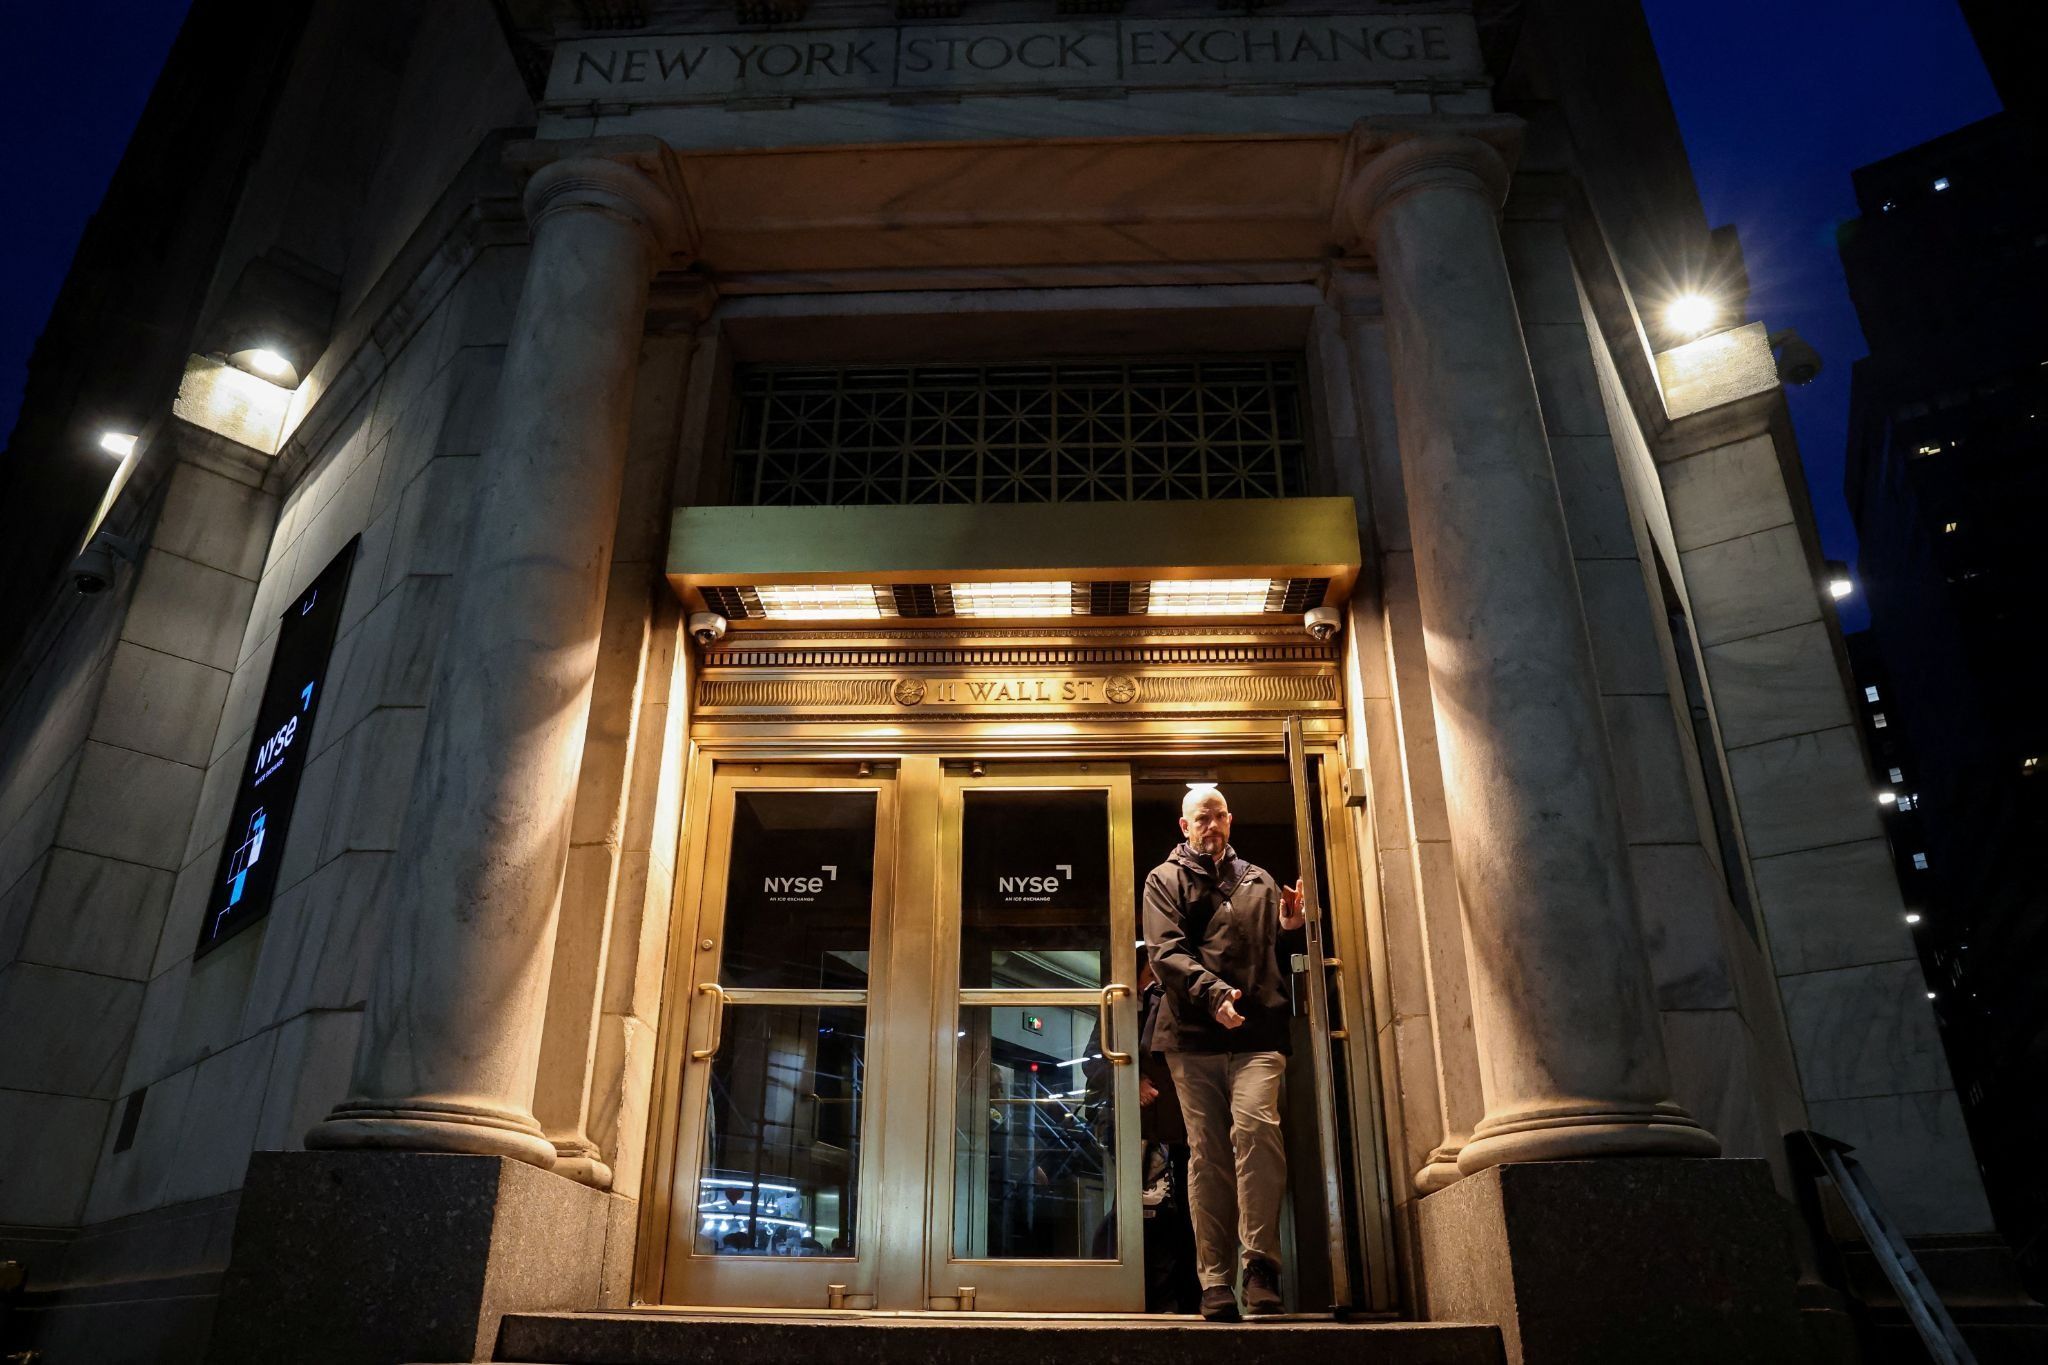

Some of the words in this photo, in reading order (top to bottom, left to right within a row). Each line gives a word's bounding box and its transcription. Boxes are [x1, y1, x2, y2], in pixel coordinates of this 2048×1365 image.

[574, 46, 711, 85] NEW
[727, 41, 881, 79] YORK
[905, 34, 1097, 72] STOCK
[1130, 26, 1451, 65] EXCHANGE
[937, 682, 956, 702] 11
[965, 681, 1051, 702] WALL
[1062, 681, 1095, 701] ST
